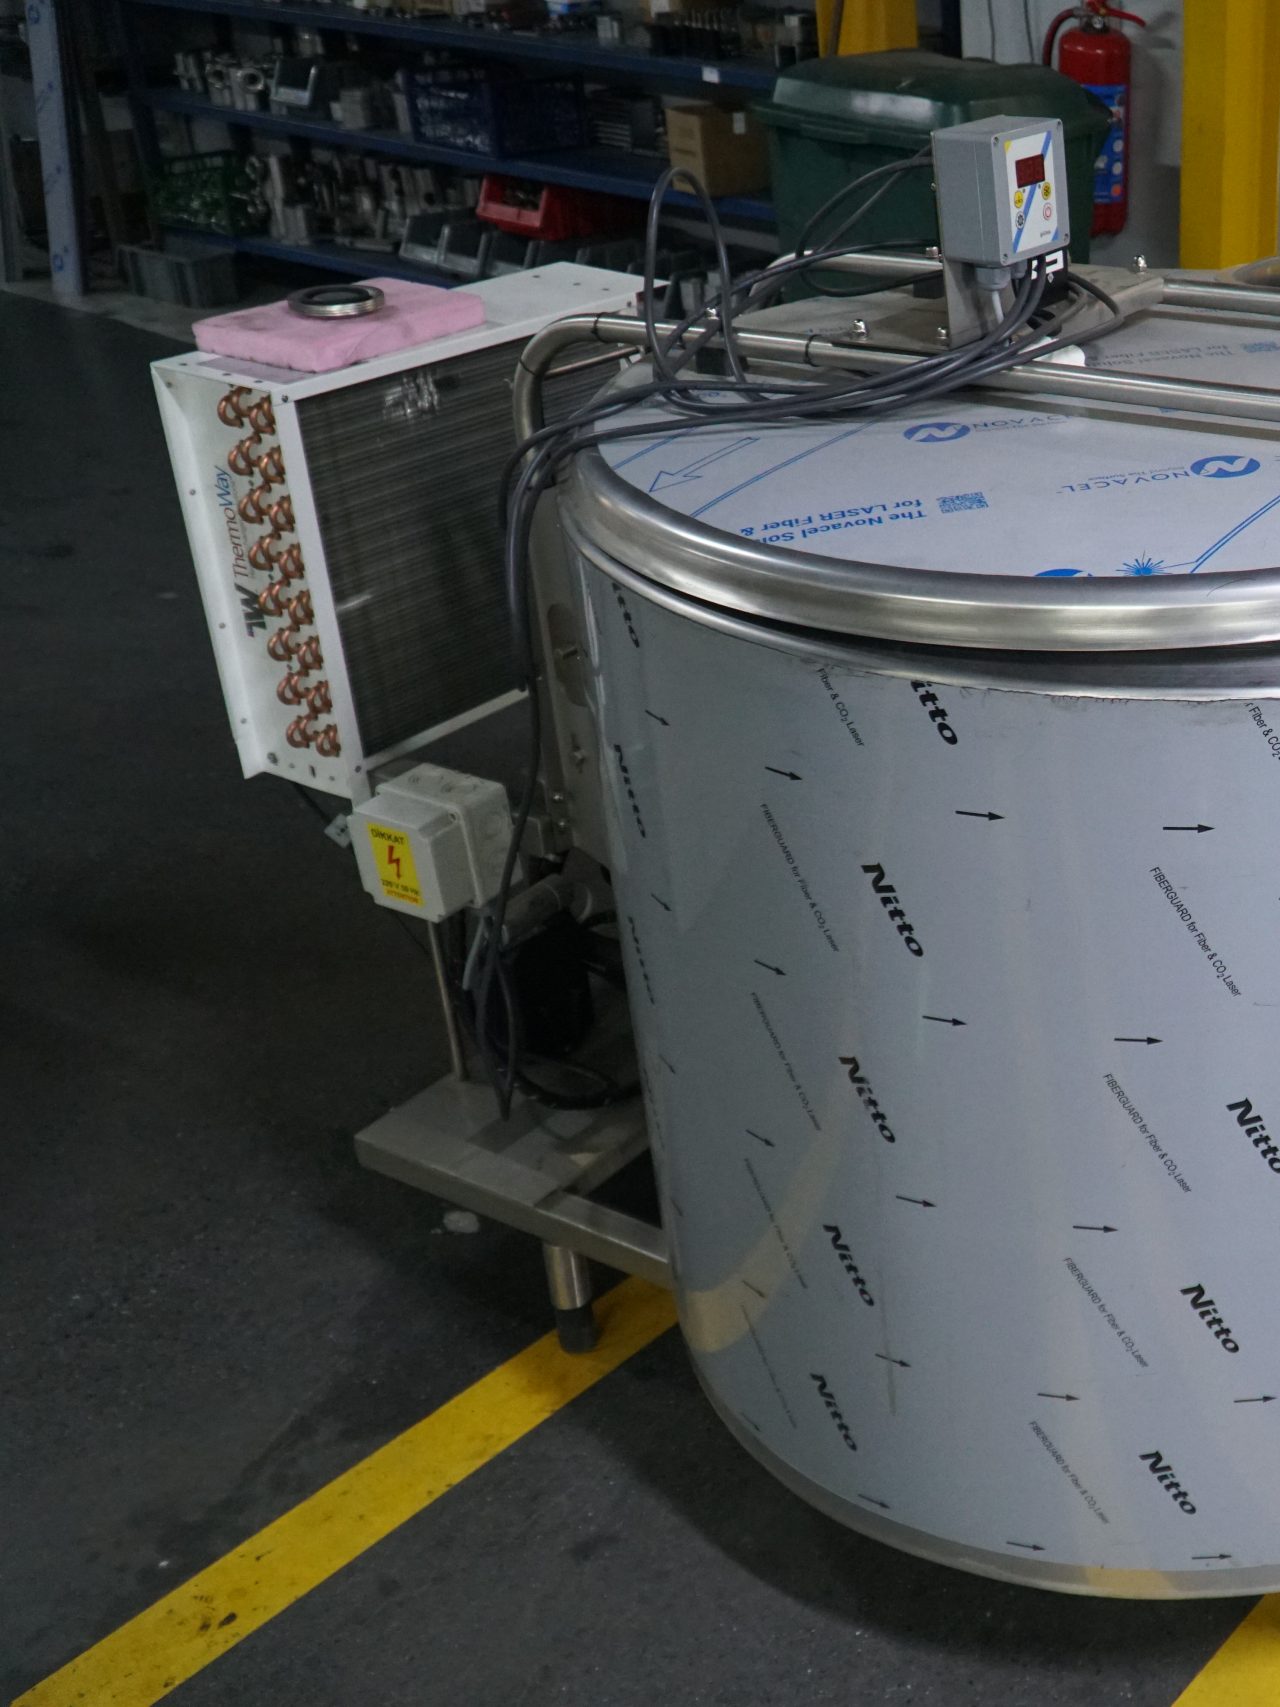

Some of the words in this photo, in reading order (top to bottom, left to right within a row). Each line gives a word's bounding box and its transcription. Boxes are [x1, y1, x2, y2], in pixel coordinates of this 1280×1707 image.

[214, 465, 249, 578] ThermoWay
[761, 516, 813, 531] Fiber
[801, 516, 883, 538] Novacel
[819, 504, 886, 521] LASER
[889, 509, 927, 521] The
[892, 499, 922, 509] for
[816, 668, 834, 691] Fiber
[846, 721, 865, 747] Laser
[1249, 706, 1267, 729] Fiber
[1262, 728, 1273, 737] &
[861, 863, 923, 957] Nitto
[1149, 866, 1192, 922] FIBERGUARD
[1186, 921, 1199, 934] for
[1194, 932, 1212, 953] Fiber
[1207, 952, 1217, 961] &
[1222, 974, 1242, 997] Laser
[838, 1056, 896, 1144] Nitto
[1103, 1073, 1144, 1125] FIBERGUARD
[823, 1224, 875, 1306] Nitto
[1180, 1283, 1240, 1354] Nitto
[810, 1373, 858, 1452] Nitto
[1138, 1451, 1197, 1515] Nitto
